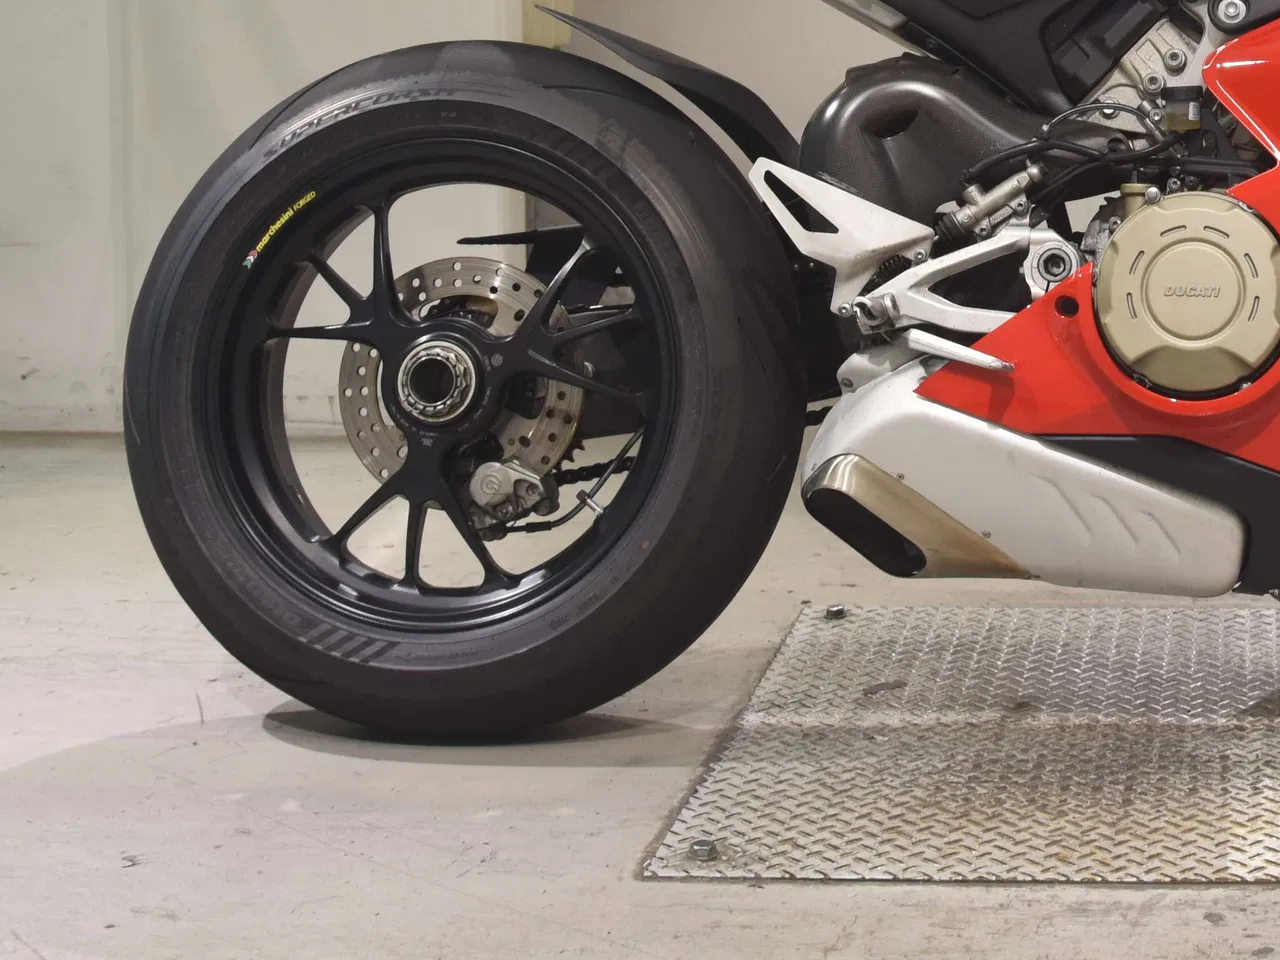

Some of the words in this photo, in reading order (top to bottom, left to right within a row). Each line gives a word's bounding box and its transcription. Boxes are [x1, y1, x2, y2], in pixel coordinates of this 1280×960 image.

[256, 207, 294, 252] marchesini
[293, 191, 316, 211] FORGED
[1164, 286, 1221, 298] DUCATI
